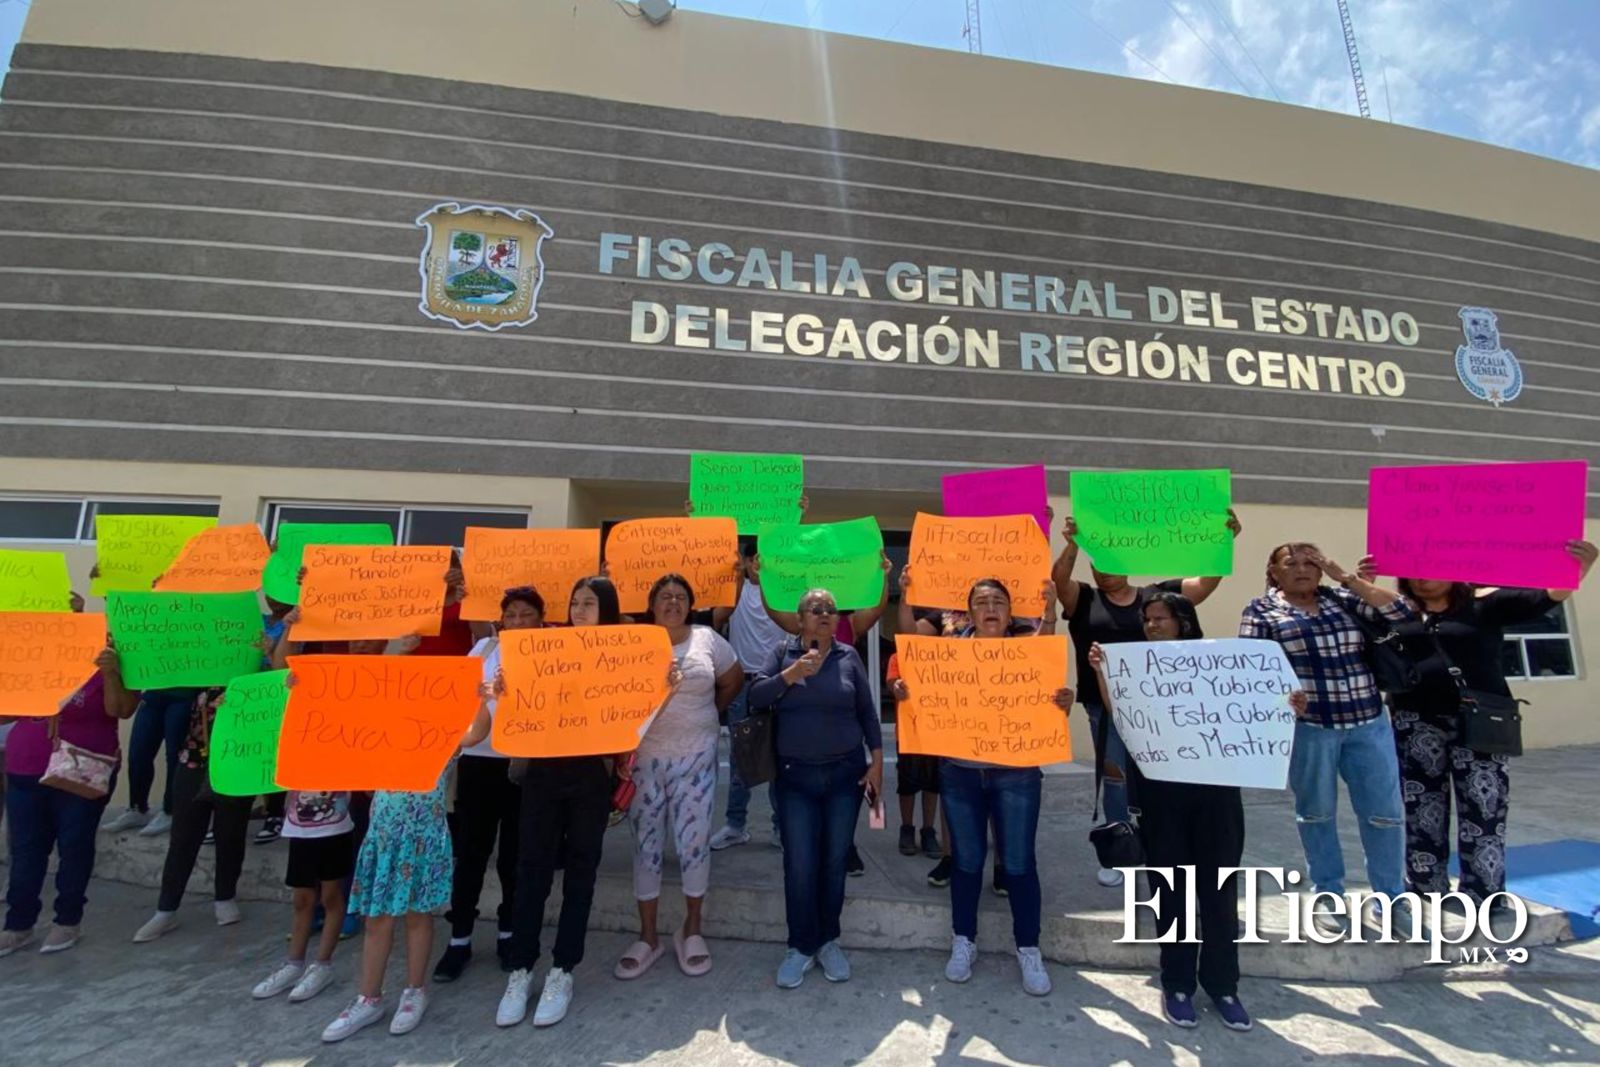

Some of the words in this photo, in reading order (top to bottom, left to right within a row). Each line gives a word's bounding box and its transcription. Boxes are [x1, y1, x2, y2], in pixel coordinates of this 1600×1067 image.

[599, 232, 871, 299] FISCALIA
[885, 261, 1134, 320] GENERAL
[1148, 285, 1239, 330] DEL
[1252, 295, 1420, 346] ESTADO
[630, 299, 1000, 369] DELEGACIÓN
[1019, 331, 1211, 383] REGIÓN
[1225, 347, 1406, 398] CENTRO
[1469, 355, 1508, 368] FISCALIA
[1470, 366, 1509, 378] GENERAL
[518, 633, 565, 657] Clara
[575, 629, 642, 651] Yubisela
[904, 640, 958, 663] Alcalde
[971, 639, 1028, 664] Carlos
[532, 658, 582, 679] Valera
[595, 650, 657, 673] Aguirre
[914, 665, 980, 686] Villareal
[988, 667, 1042, 686] donde
[1103, 650, 1132, 679] LA
[1145, 648, 1283, 679] Aseguranza
[955, 690, 969, 708] la
[1112, 681, 1132, 700] de
[1139, 676, 1194, 698] Clara
[557, 715, 588, 729] bien
[927, 712, 990, 731] Justicia
[1168, 701, 1221, 727] Esta
[296, 709, 393, 751] Para
[1177, 745, 1200, 760] es
